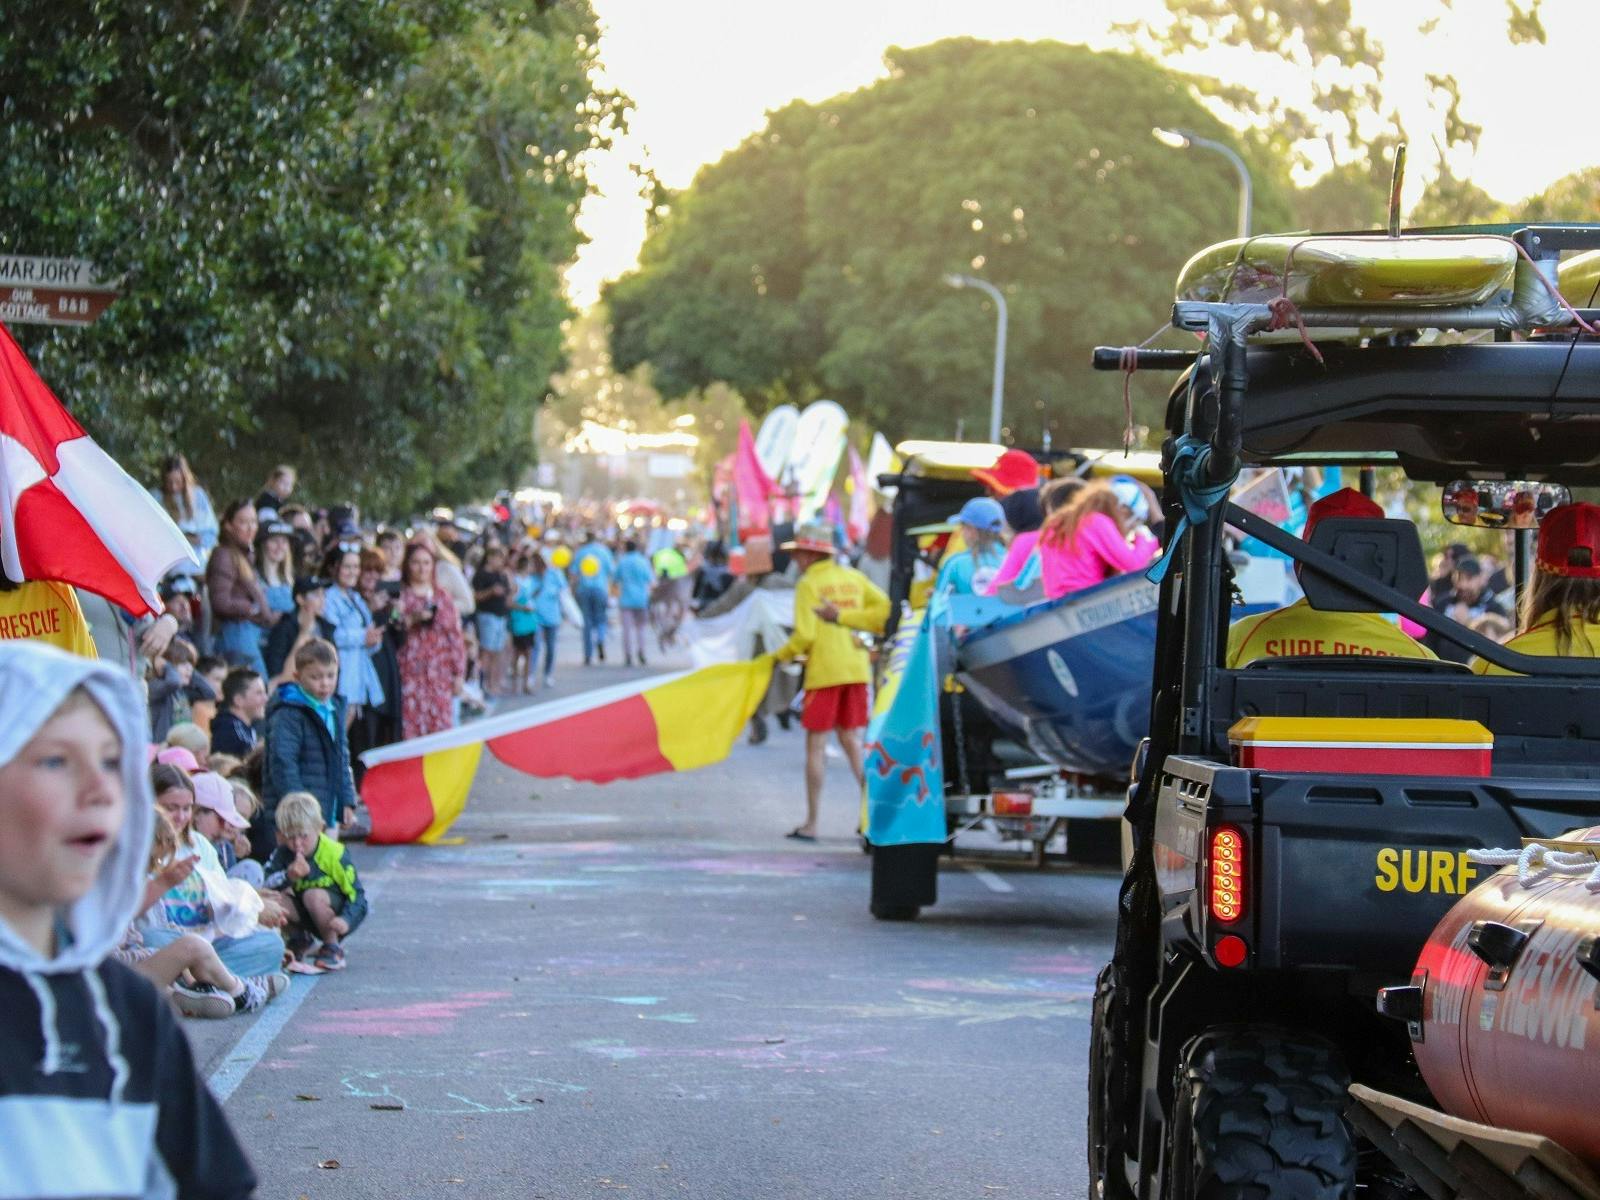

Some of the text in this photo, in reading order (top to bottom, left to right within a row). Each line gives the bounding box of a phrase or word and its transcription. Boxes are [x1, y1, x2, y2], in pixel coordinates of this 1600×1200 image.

[0, 260, 80, 282] MARJORY
[59, 296, 88, 314] B&B
[0, 608, 60, 639] RESCUE
[1375, 847, 1477, 895] SURF
